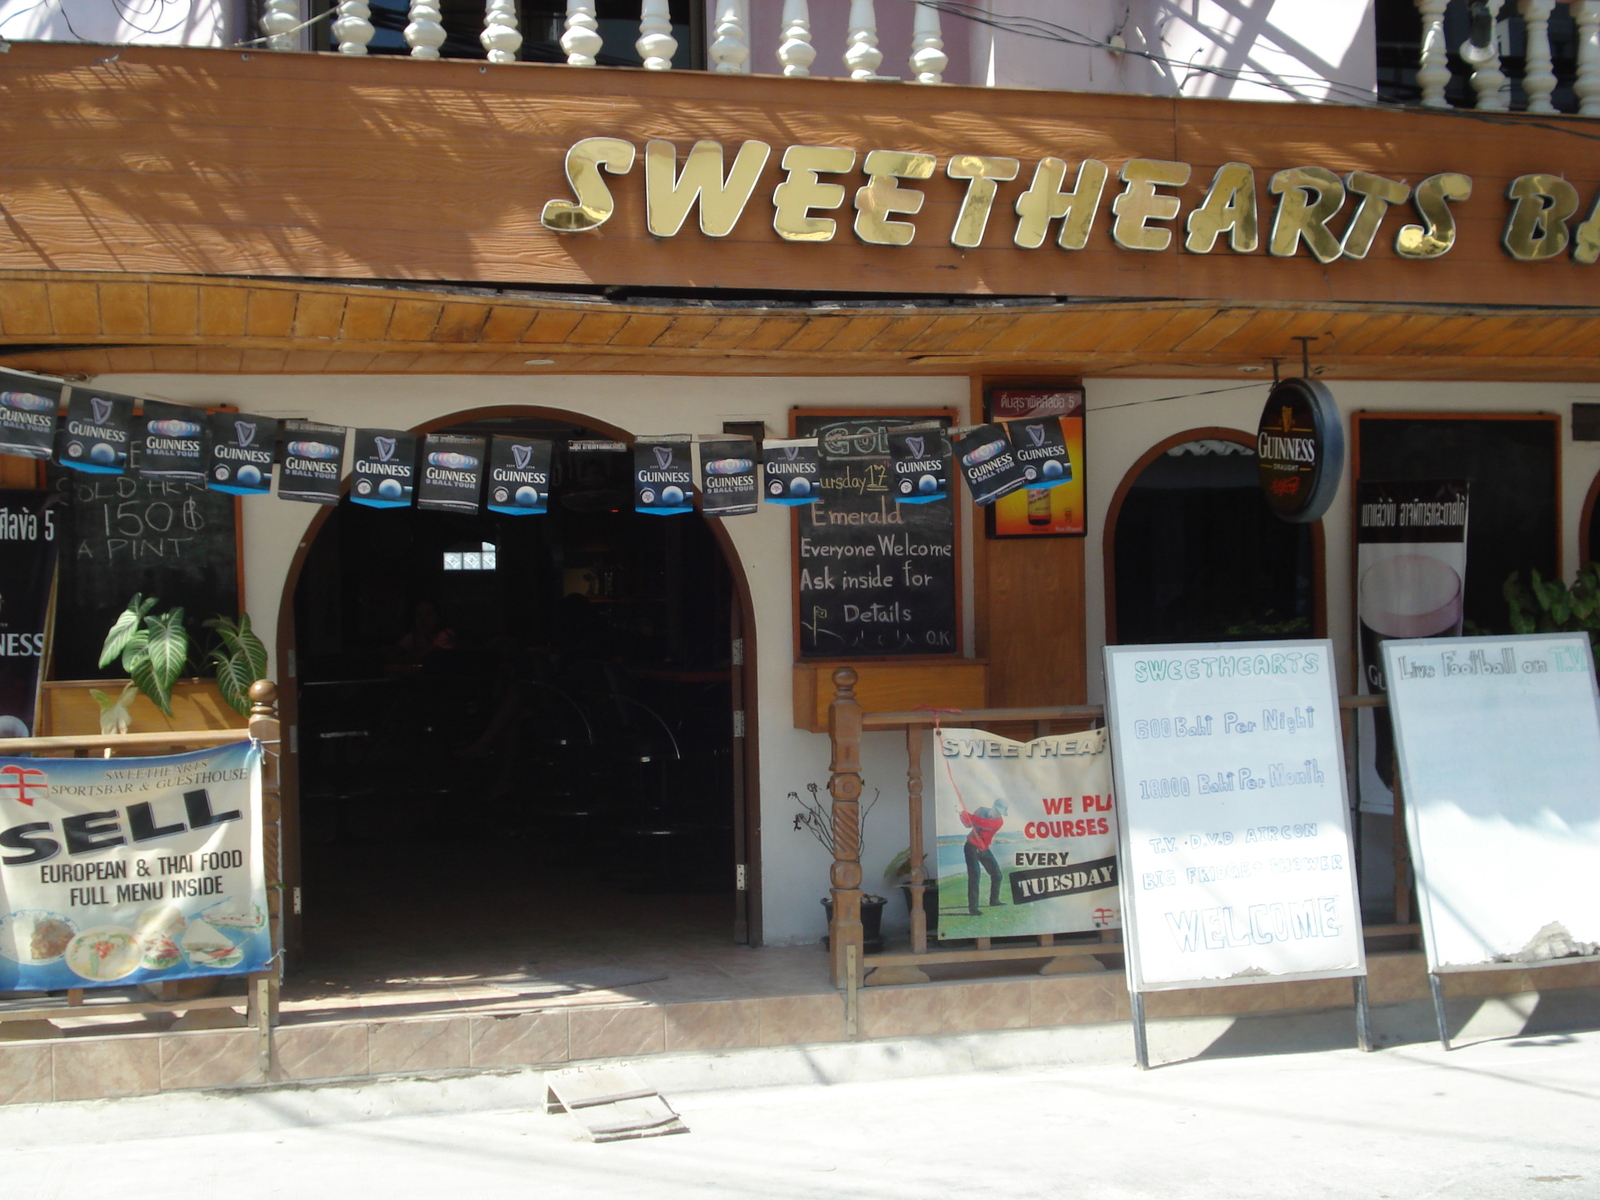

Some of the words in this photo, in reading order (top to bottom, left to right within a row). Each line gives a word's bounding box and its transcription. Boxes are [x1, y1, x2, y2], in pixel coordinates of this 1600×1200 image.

[541, 136, 1473, 264] SWEETHEARTS
[1068, 395, 1075, 408] 5
[0, 407, 52, 427] GUINNESS
[3, 420, 25, 431] BALL
[27, 423, 50, 433] TOUR
[68, 420, 127, 442] GUINNESS
[146, 436, 200, 451] GUINNESS
[177, 450, 199, 458] TOUR
[214, 444, 270, 463] GUINNESS
[1017, 445, 1066, 461] GUINNESS
[1258, 432, 1315, 462] GUINNESS
[285, 457, 338, 474] GUINNESS
[356, 460, 411, 477] GUINNESS
[426, 467, 476, 483] GUINNESS
[493, 468, 546, 484] GUINNESS
[638, 470, 690, 483] GUINNESS
[766, 462, 816, 474] GUINNESS
[895, 460, 942, 473] GUINNESS
[968, 452, 1012, 479] GUINNESS
[977, 472, 996, 482] BALL
[996, 461, 1015, 474] TOUR
[1273, 463, 1299, 472] DRAUGHT
[454, 481, 476, 489] TOUR
[706, 475, 754, 488] GUINNESS
[811, 496, 904, 526] Emerald
[44, 509, 55, 542] 5
[77, 539, 93, 560] A
[106, 537, 193, 565] PINT
[801, 537, 876, 559] Everyone
[878, 532, 951, 557] Welcome
[801, 566, 835, 591] Ask
[842, 564, 893, 590] inside
[902, 560, 933, 586] for
[843, 601, 912, 623] Details
[1134, 652, 1320, 683] SWEETHEARTS
[1398, 655, 1435, 680] Live
[1441, 647, 1517, 677] Football
[1522, 659, 1548, 674] on
[1134, 718, 1171, 739] 600
[1175, 715, 1213, 737] Baht
[1223, 711, 1256, 734] Per
[1262, 706, 1315, 734] Night
[104, 759, 208, 781] SWEETHEARTS
[1197, 771, 1235, 794] Baht
[1238, 767, 1266, 790] Per
[1268, 758, 1324, 787] Month
[51, 783, 133, 796] SPORTSBAR
[139, 781, 150, 792] &
[156, 767, 248, 790] GUESTHOUSE
[1042, 796, 1073, 815] WE
[0, 788, 243, 866] SELL
[1024, 817, 1109, 839] COURSES
[1149, 837, 1178, 853] T.V.
[41, 860, 127, 884] EUROPEAN
[136, 858, 151, 877] &
[158, 855, 193, 875] THAI
[200, 850, 243, 870] FOOD
[1015, 852, 1069, 867] EVERY
[1018, 865, 1113, 898] TUESDAY
[1142, 870, 1176, 890] BIG
[1187, 861, 1251, 884] FRIDGE
[1269, 854, 1343, 874] SHOWER
[70, 886, 109, 907] FULL
[117, 881, 163, 902] MENU
[171, 875, 223, 899] INSIDE
[1165, 895, 1343, 953] WELCOME
